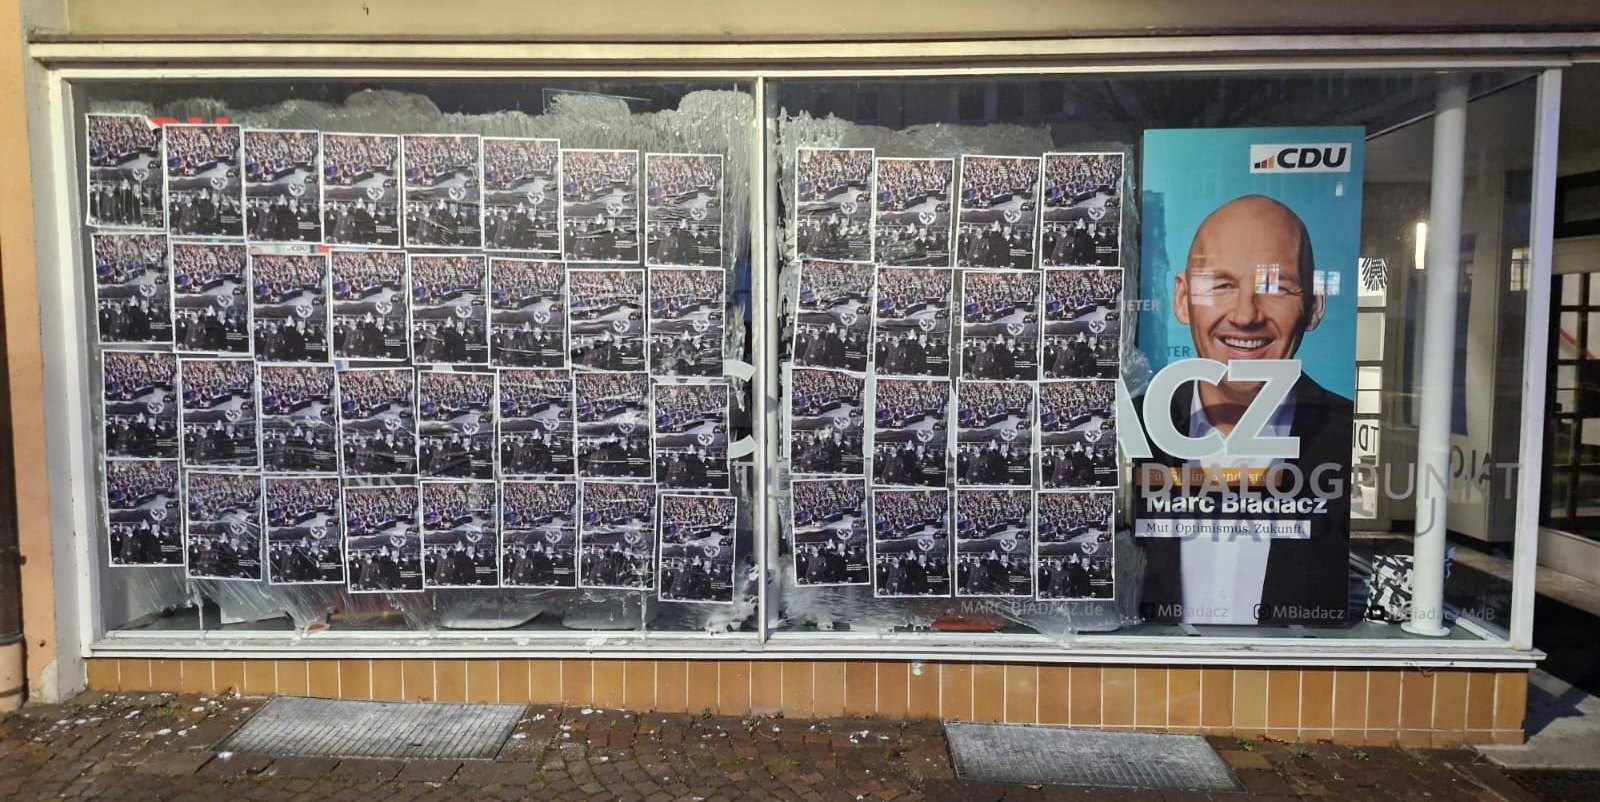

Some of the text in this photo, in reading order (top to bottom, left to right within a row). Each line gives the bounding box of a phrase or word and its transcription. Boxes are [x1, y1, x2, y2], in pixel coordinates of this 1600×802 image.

[1276, 147, 1347, 169] CDU
[1141, 462, 1522, 501] DIALOGPUNKT
[1146, 493, 1328, 515] Marc Biadacz
[1158, 604, 1229, 618] MBadacz
[1273, 605, 1345, 619] MBiadacz
